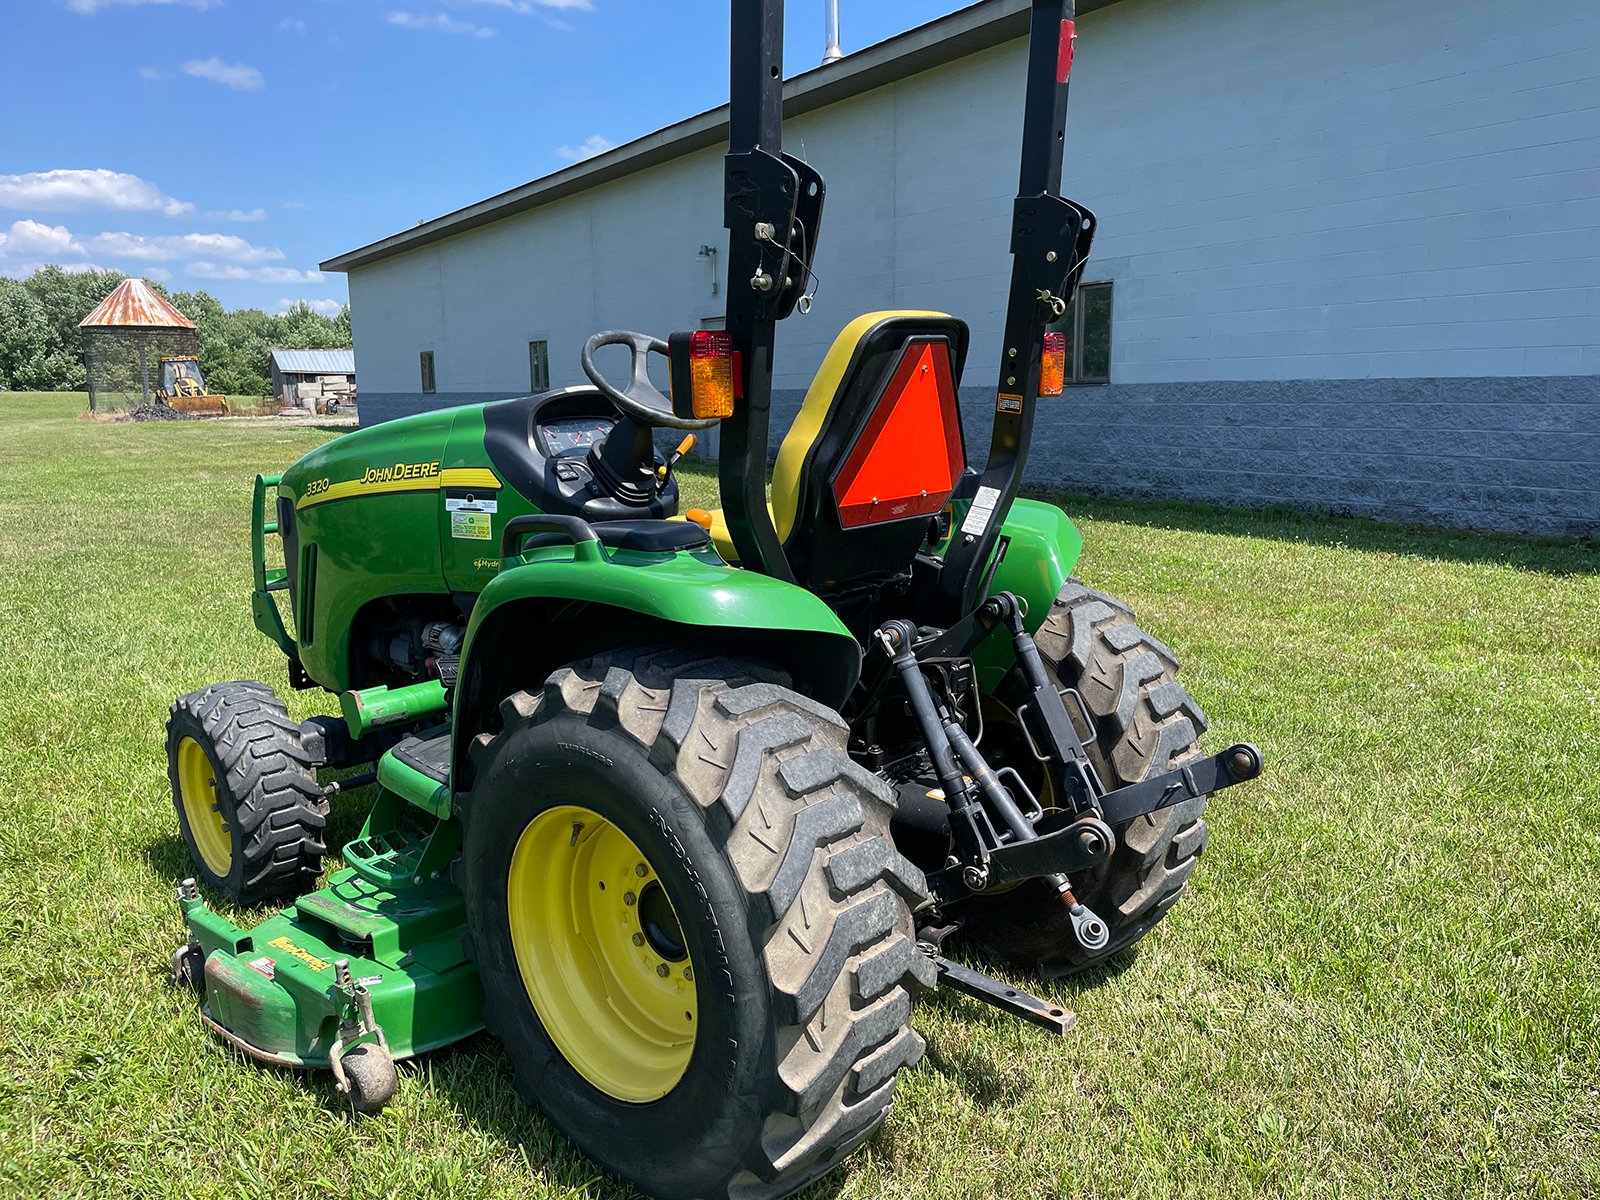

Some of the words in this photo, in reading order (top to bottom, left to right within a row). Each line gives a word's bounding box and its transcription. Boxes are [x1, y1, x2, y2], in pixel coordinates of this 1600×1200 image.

[360, 465, 393, 484] JOHN
[393, 461, 440, 481] DEERE
[306, 477, 330, 497] 3320
